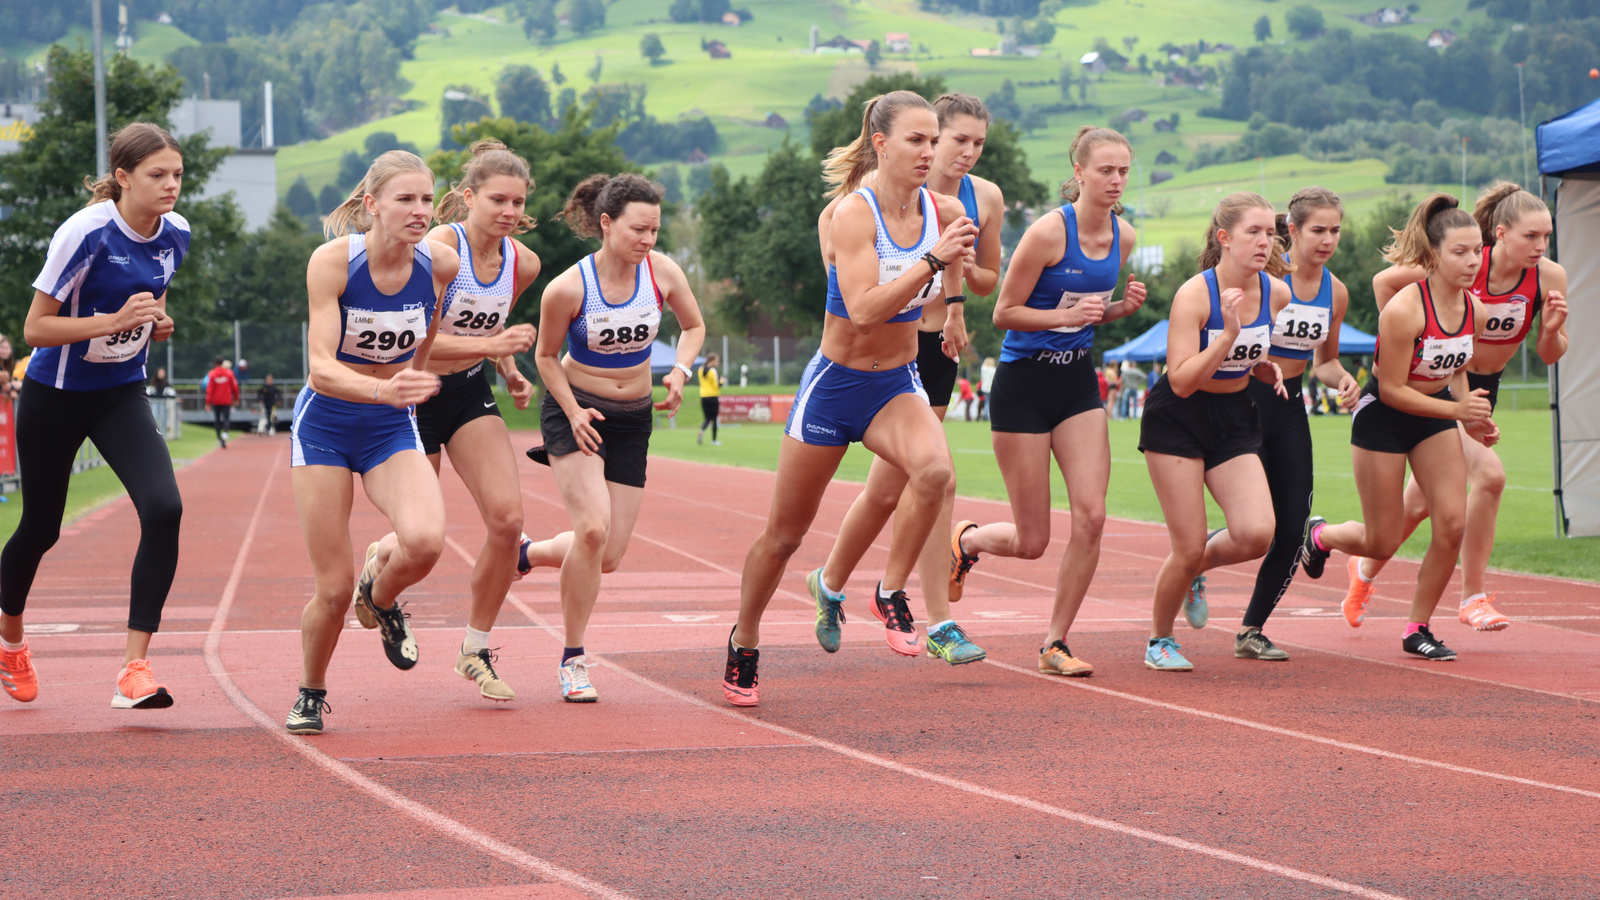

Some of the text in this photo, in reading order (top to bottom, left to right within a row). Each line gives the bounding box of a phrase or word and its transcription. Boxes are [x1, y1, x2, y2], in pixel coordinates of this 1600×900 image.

[453, 310, 500, 330] 289
[1283, 320, 1322, 340] 183
[1486, 317, 1515, 331] 06
[106, 325, 144, 346] 393
[356, 330, 415, 351] 290
[599, 324, 649, 346] 288
[1037, 350, 1073, 364] PRO
[1429, 352, 1467, 370] 308
